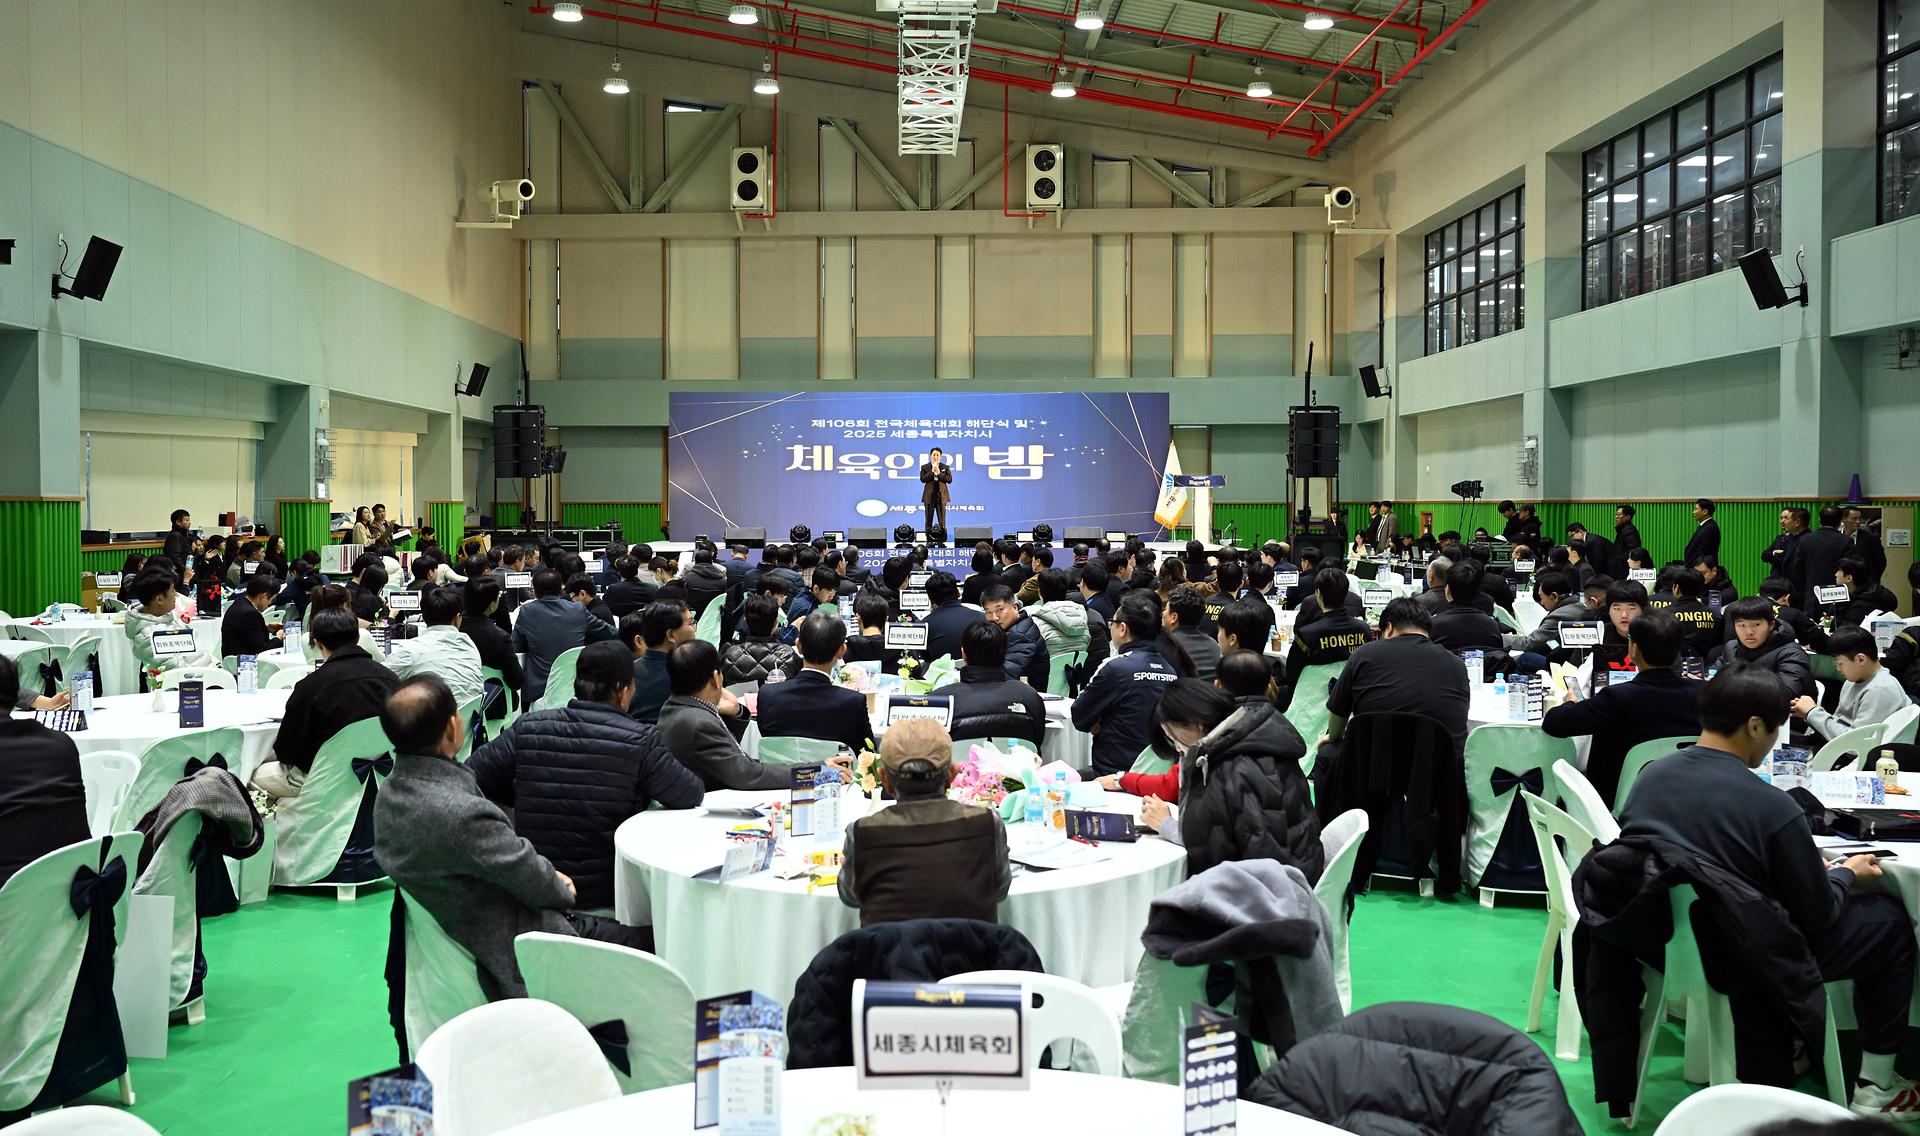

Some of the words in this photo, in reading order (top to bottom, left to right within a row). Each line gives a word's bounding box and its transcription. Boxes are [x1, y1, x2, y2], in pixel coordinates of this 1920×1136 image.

[811, 418, 870, 429] 제106회
[874, 418, 962, 429] 전국체육대회
[965, 418, 1009, 429] 해단식
[1013, 418, 1028, 429] 및
[843, 429, 886, 439] 2025
[890, 429, 993, 439] 세종특별자치시
[973, 444, 1055, 480] 밤
[863, 559, 888, 567] 202
[1675, 611, 1714, 622] ONGIK
[156, 640, 192, 648] 회원종목단체
[1319, 632, 1365, 650] HONGIK
[872, 1033, 1014, 1056] 세종시체육회
